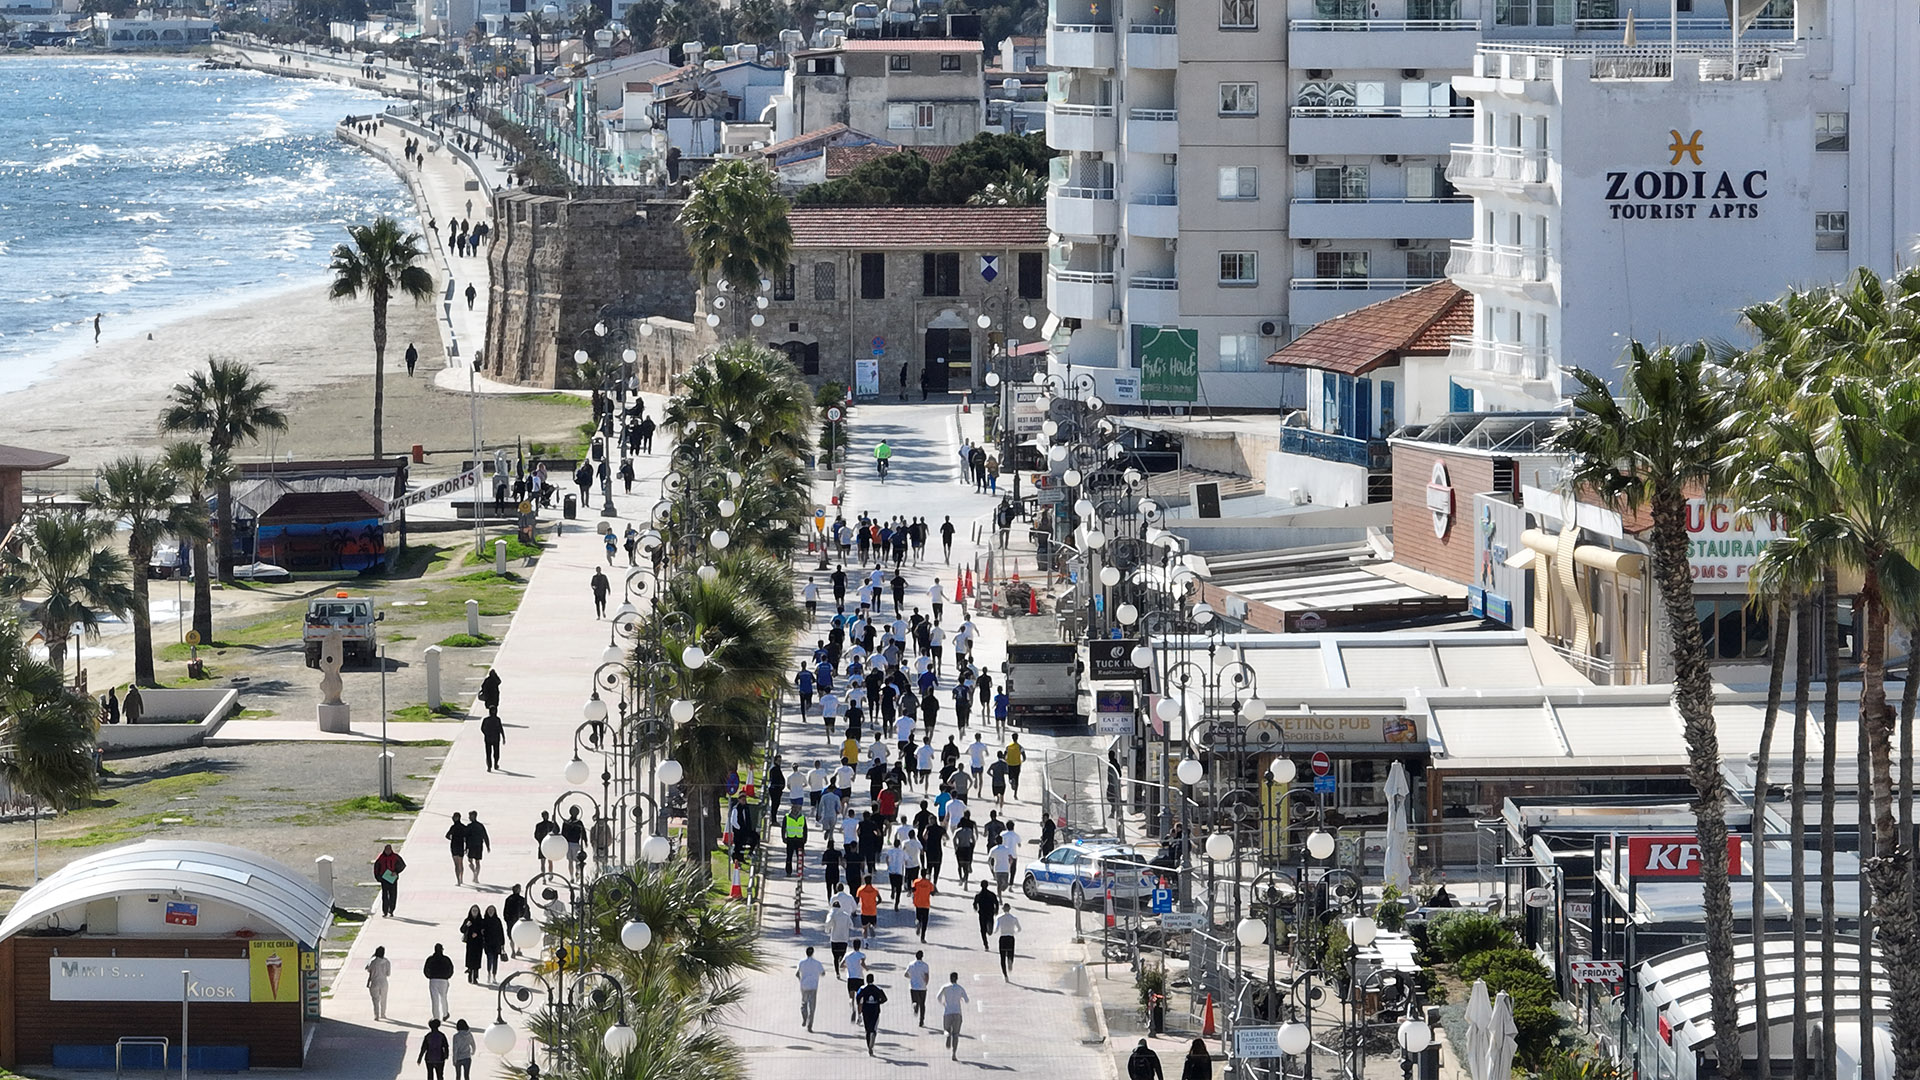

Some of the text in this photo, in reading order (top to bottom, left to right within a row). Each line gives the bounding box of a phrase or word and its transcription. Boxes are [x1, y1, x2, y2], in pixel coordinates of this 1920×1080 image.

[1605, 170, 1768, 200] ZODIAC
[1610, 203, 1759, 219] TOURIST APTS
[829, 410, 839, 419] 30
[388, 472, 475, 511] WATER SPORTS
[1686, 504, 1753, 532] UCK
[1095, 660, 1120, 668] TUCK
[1339, 718, 1371, 730] PUB
[1283, 731, 1345, 741] SPORTS BAR
[1645, 844, 1702, 870] KF
[1156, 890, 1168, 905] P
[1570, 904, 1591, 912] TAXI
[253, 941, 294, 949] SOFT ICE CREAM
[1582, 969, 1617, 977] FRIDAYS
[186, 981, 236, 998] KIOSK
